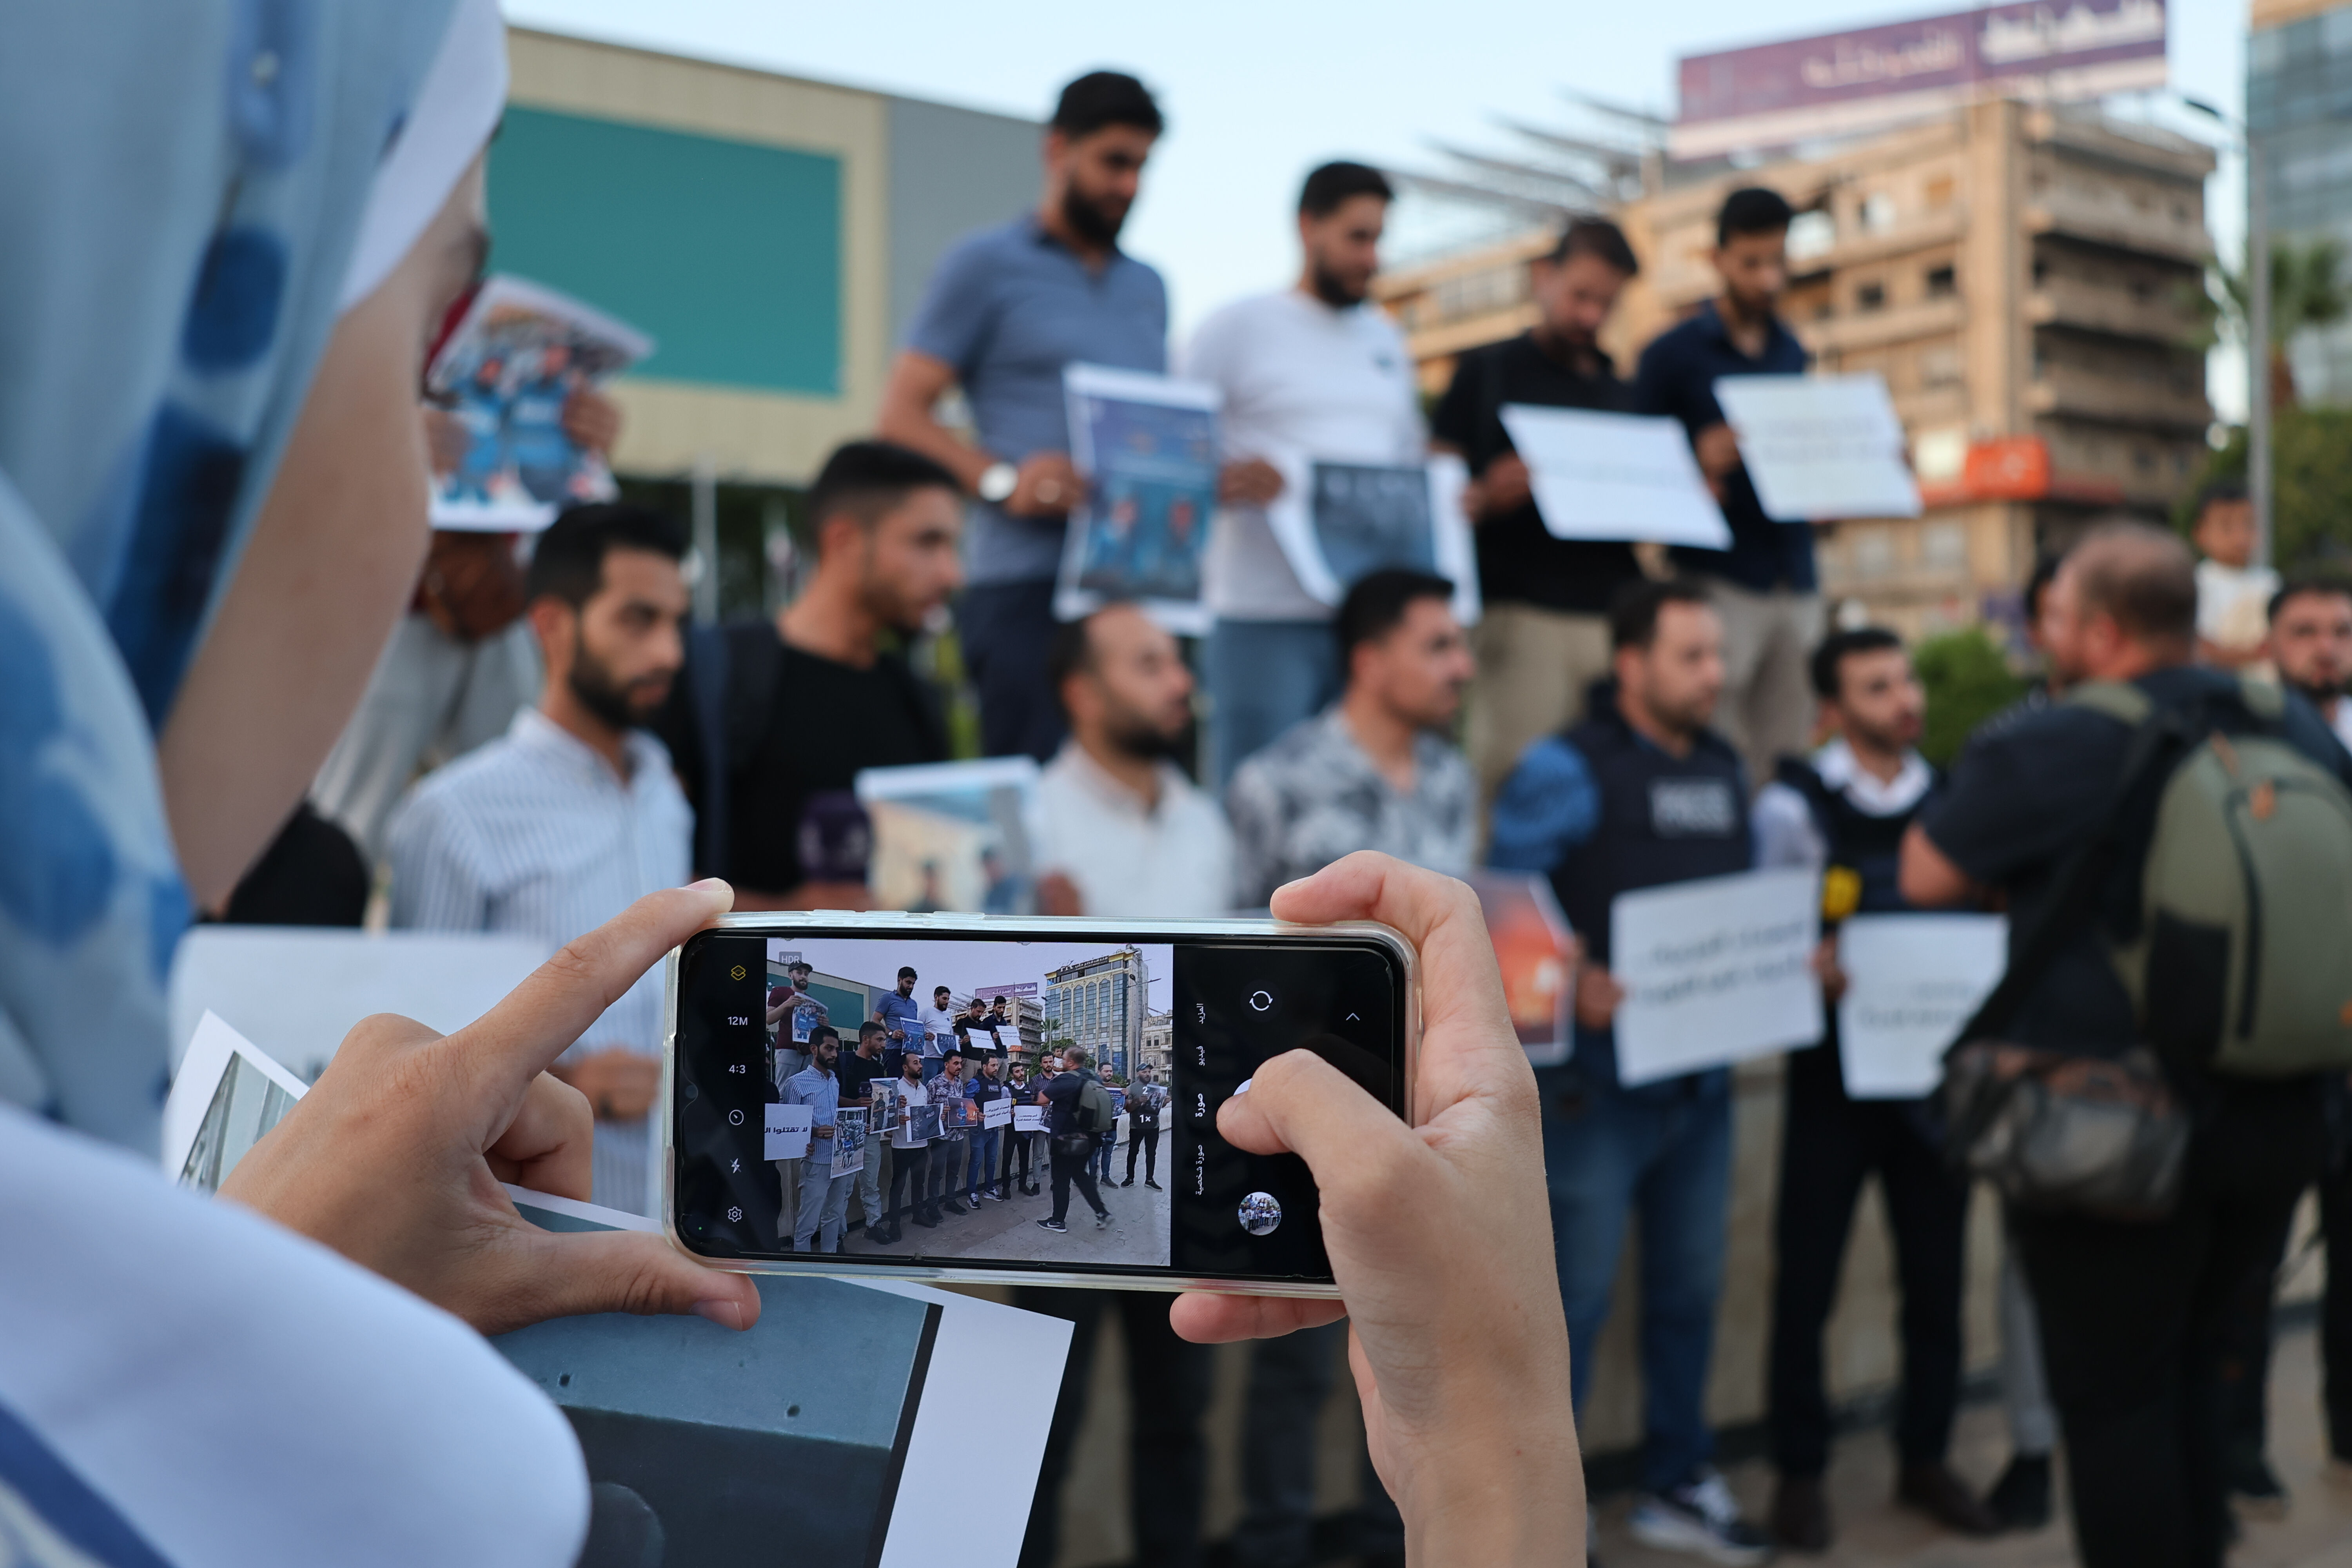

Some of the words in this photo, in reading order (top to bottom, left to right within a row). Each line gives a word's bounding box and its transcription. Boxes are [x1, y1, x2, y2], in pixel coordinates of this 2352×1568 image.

[728, 1016, 748, 1025] 12M
[1196, 1003, 1205, 1024] المزيد
[1196, 1045, 1205, 1066] فيديو
[729, 1065, 745, 1074] 4:3
[1142, 1086, 1148, 1094] 2
[1195, 1093, 1205, 1117] صورة
[1195, 1145, 1204, 1164] صورة
[1195, 1166, 1204, 1195] شخصية
